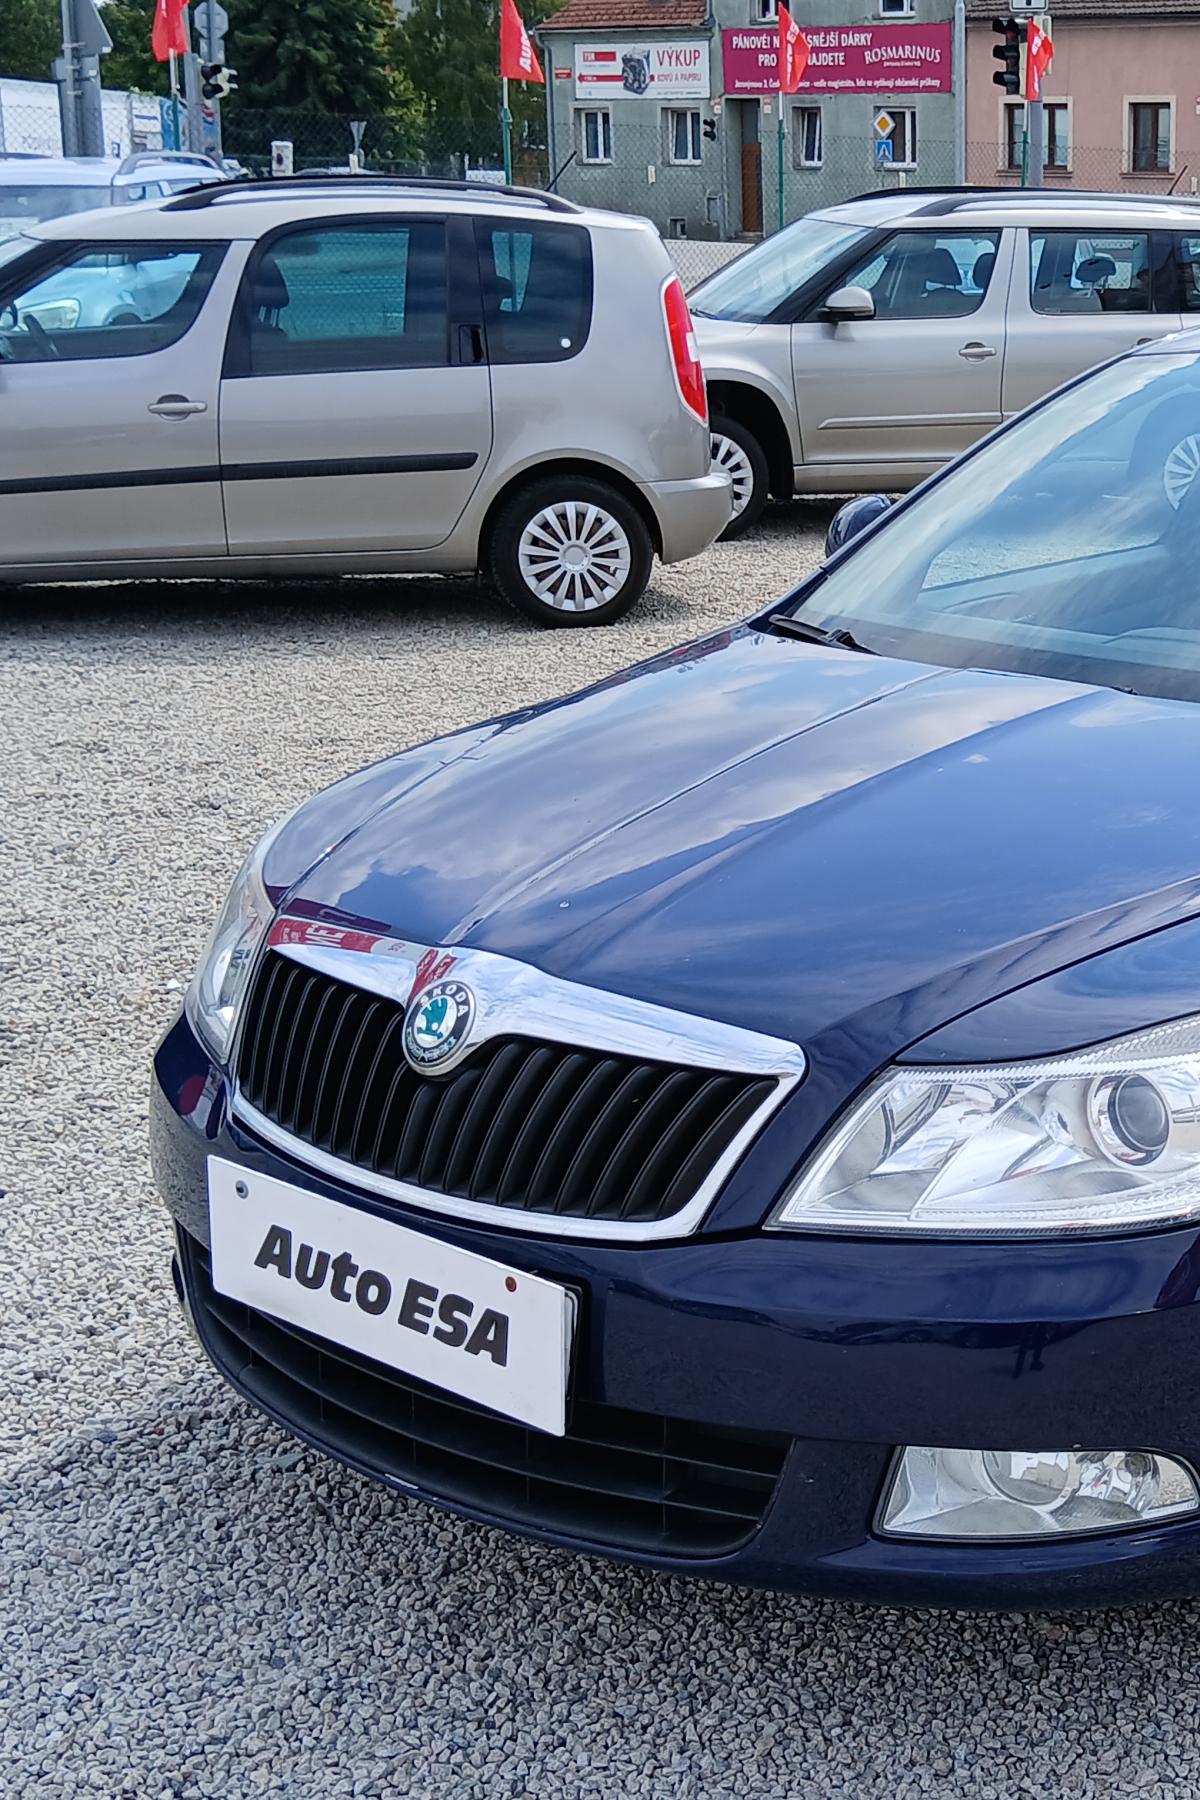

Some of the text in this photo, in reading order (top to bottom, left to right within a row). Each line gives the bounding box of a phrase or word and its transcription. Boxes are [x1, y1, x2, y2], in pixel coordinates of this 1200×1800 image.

[841, 30, 873, 47] DÁRKY
[656, 46, 701, 66] VÝKUP
[758, 53, 777, 67] PRO
[864, 45, 942, 65] ROSMARINUS
[254, 1223, 510, 1368] Auto ESA
